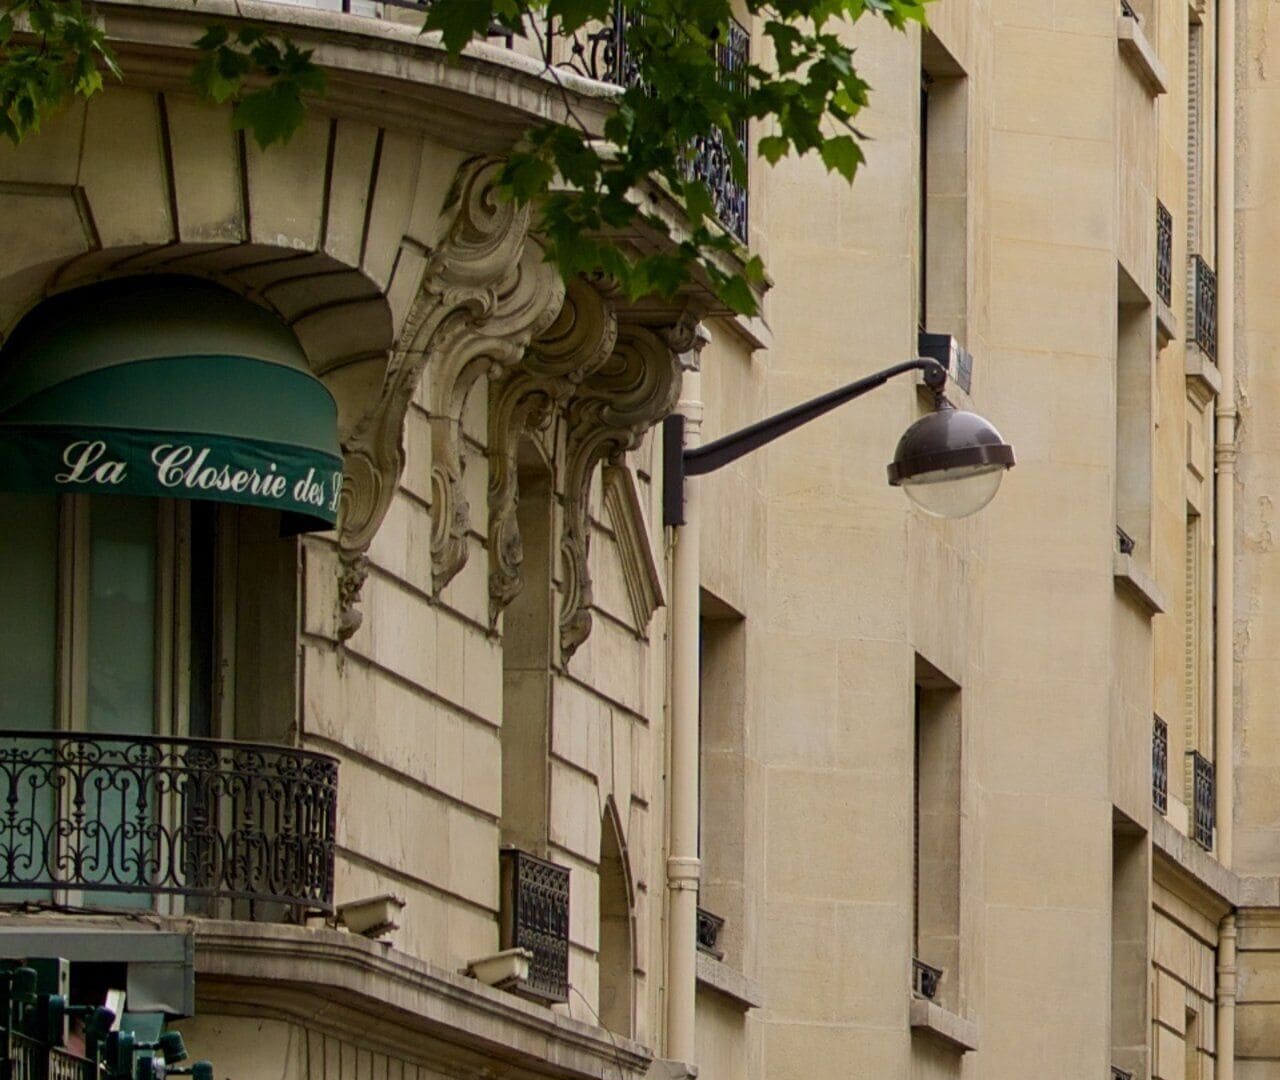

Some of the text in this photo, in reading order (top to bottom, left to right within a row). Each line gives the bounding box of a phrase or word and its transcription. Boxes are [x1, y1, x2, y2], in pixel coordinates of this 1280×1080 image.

[55, 439, 128, 485] La
[151, 444, 287, 497] Closerie
[294, 466, 325, 507] des
